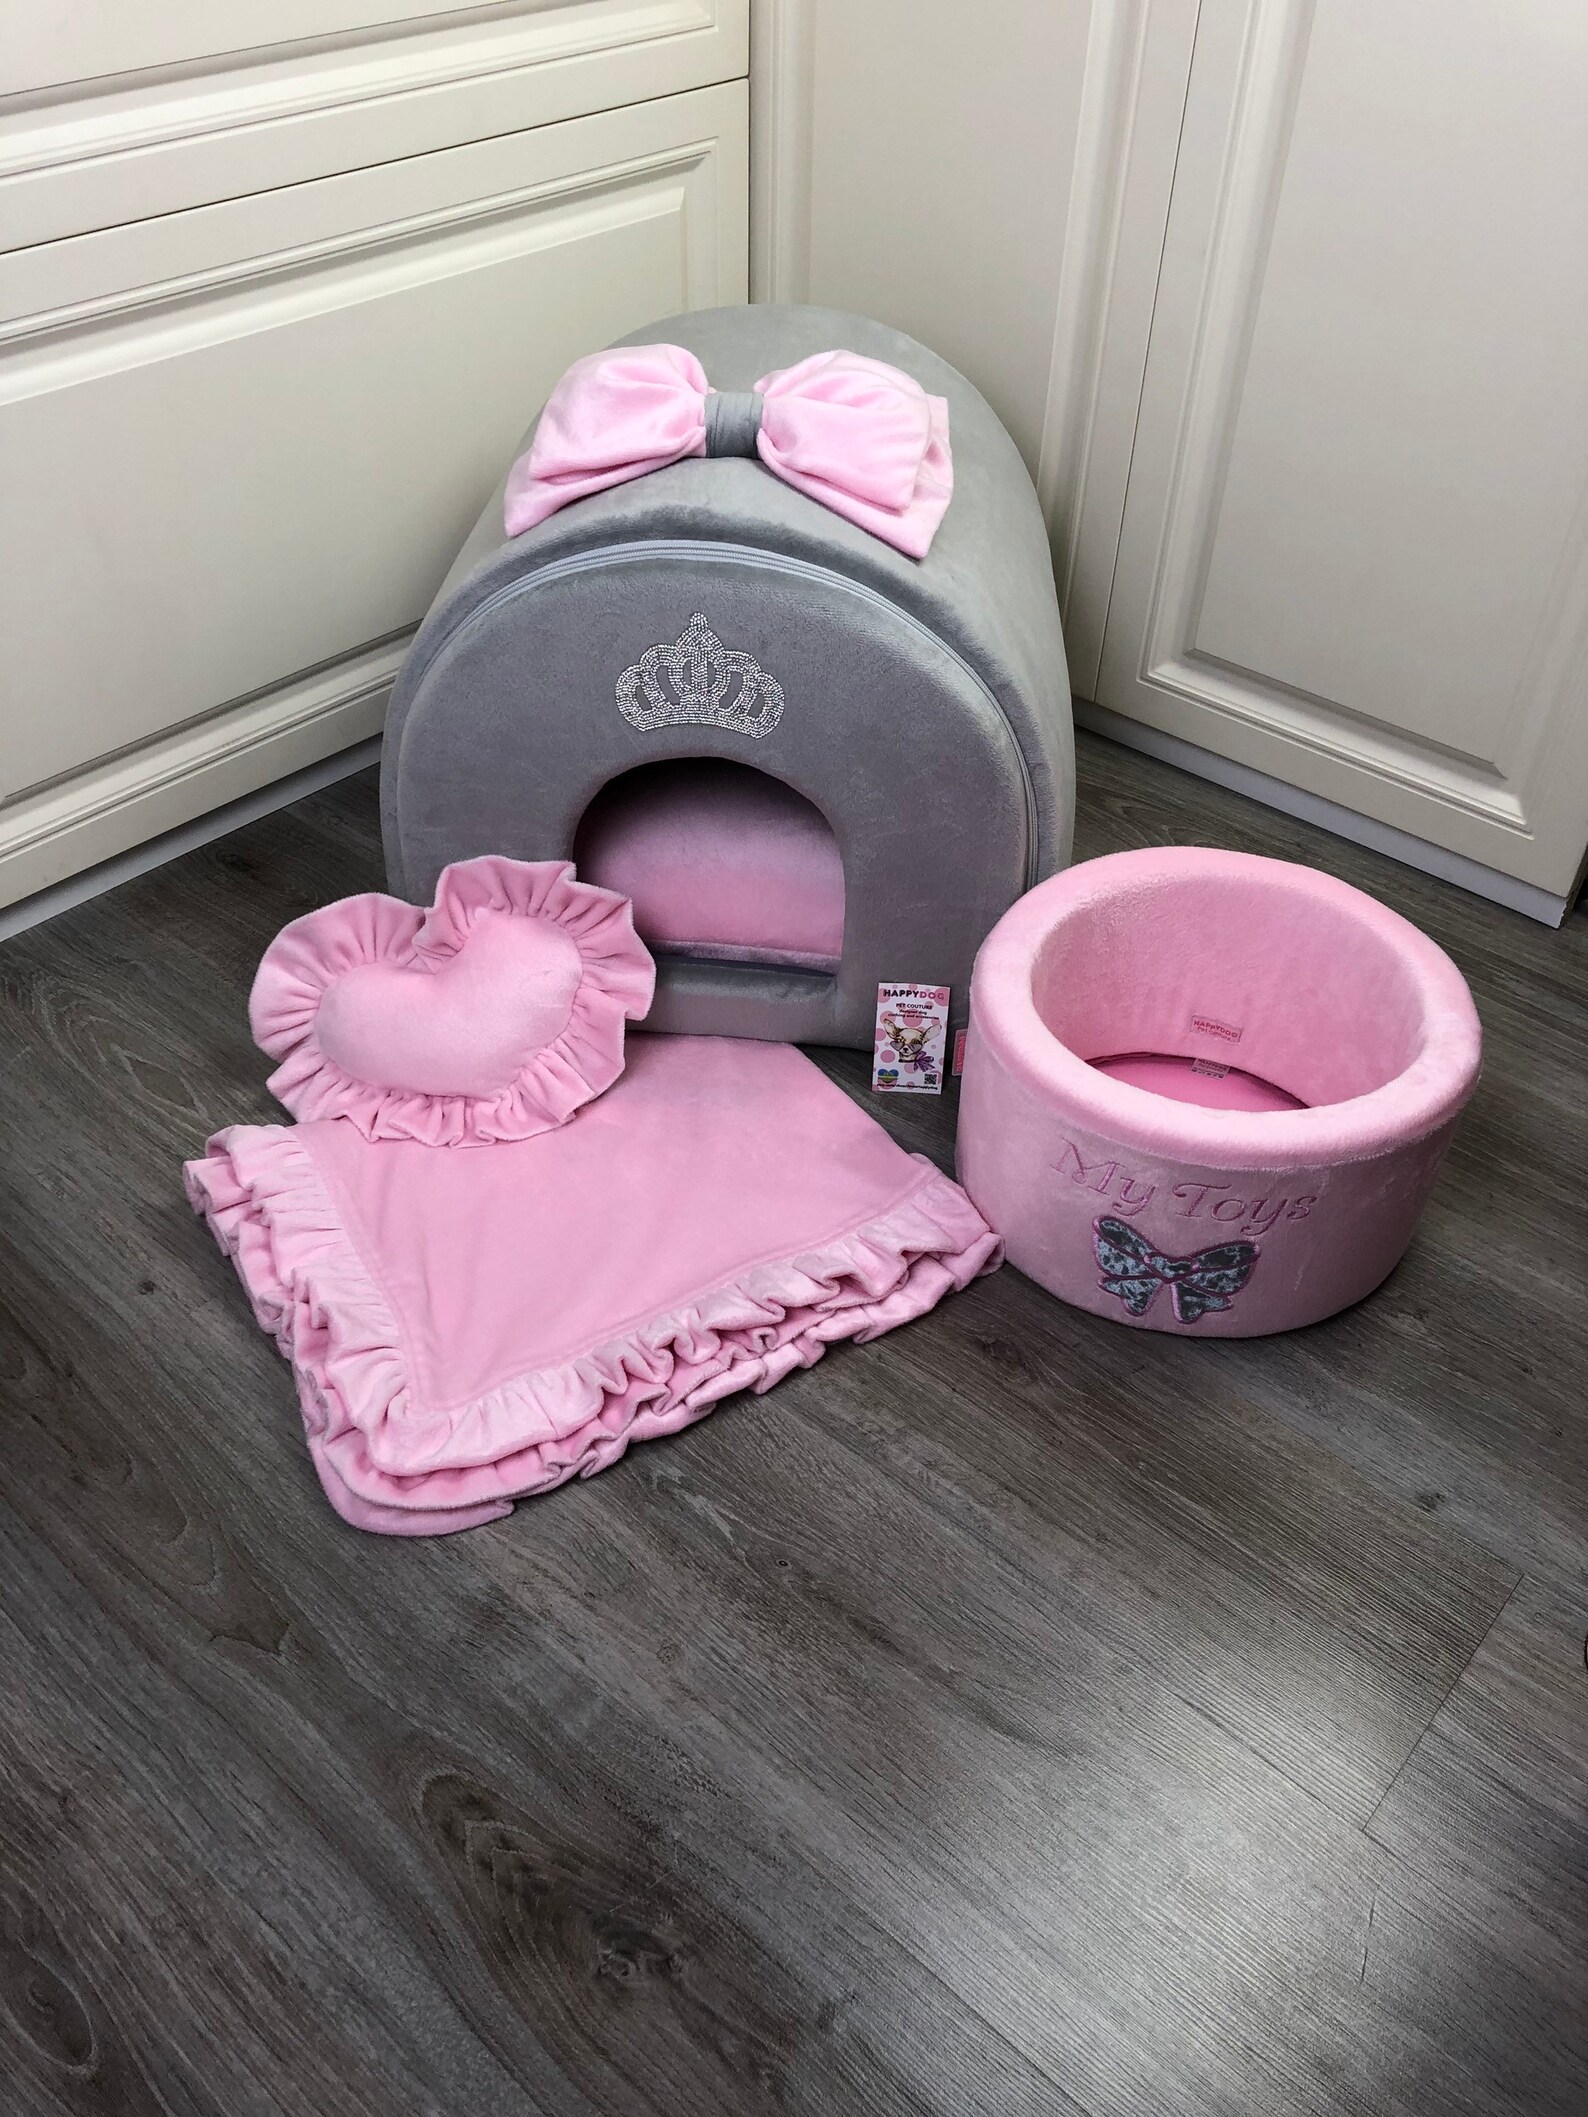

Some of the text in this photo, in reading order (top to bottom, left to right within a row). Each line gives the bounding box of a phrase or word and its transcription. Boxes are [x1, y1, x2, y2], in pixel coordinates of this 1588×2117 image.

[883, 989, 945, 1000] HAPPYDOG
[1050, 1137, 1318, 1236] My Toys
